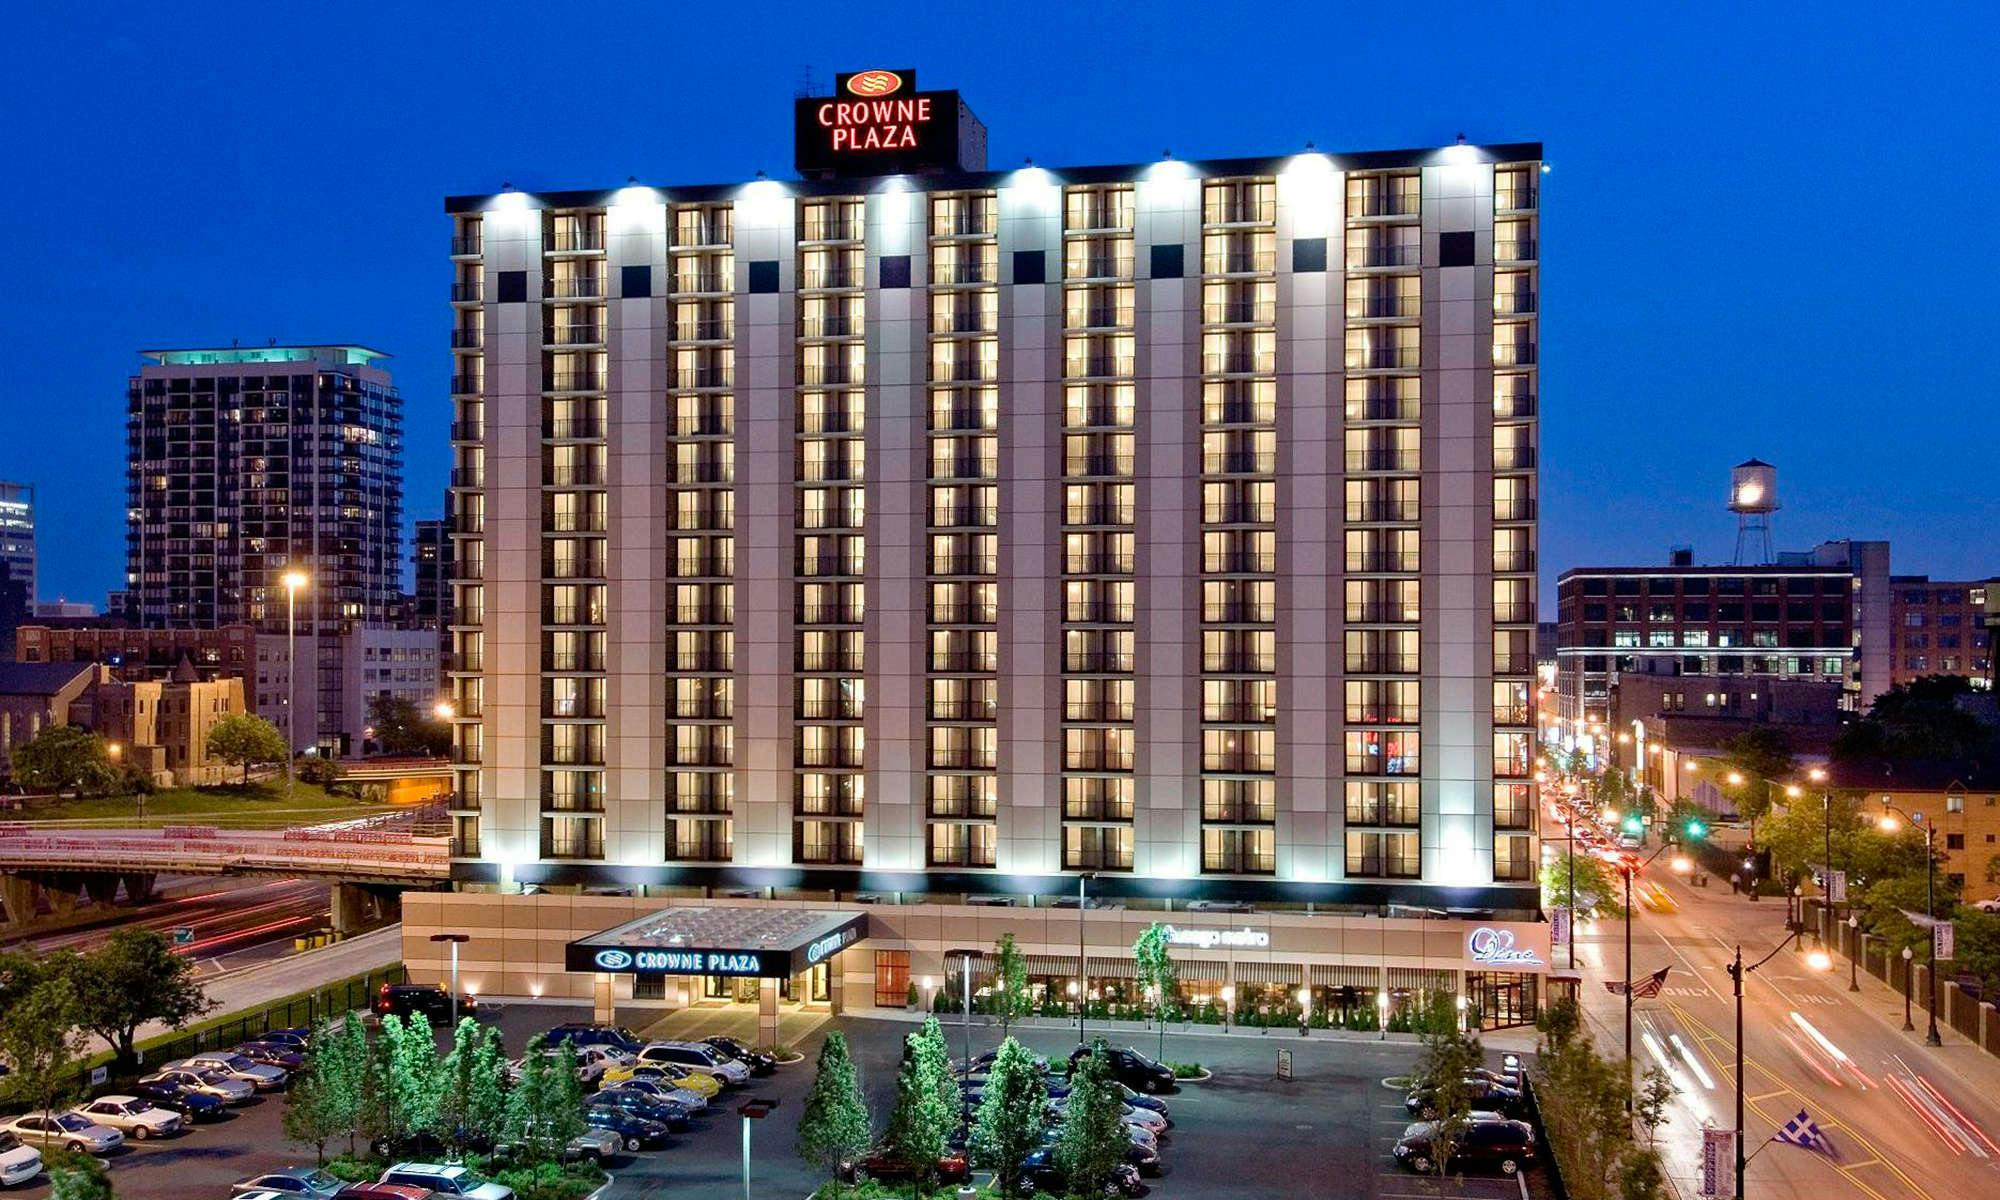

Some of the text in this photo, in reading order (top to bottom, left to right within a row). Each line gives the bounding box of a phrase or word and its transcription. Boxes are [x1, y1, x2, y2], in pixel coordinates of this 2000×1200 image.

[818, 98, 931, 127] CROWNE
[833, 125, 916, 151] PLAZA
[635, 951, 760, 973] CROWNE PLAZA
